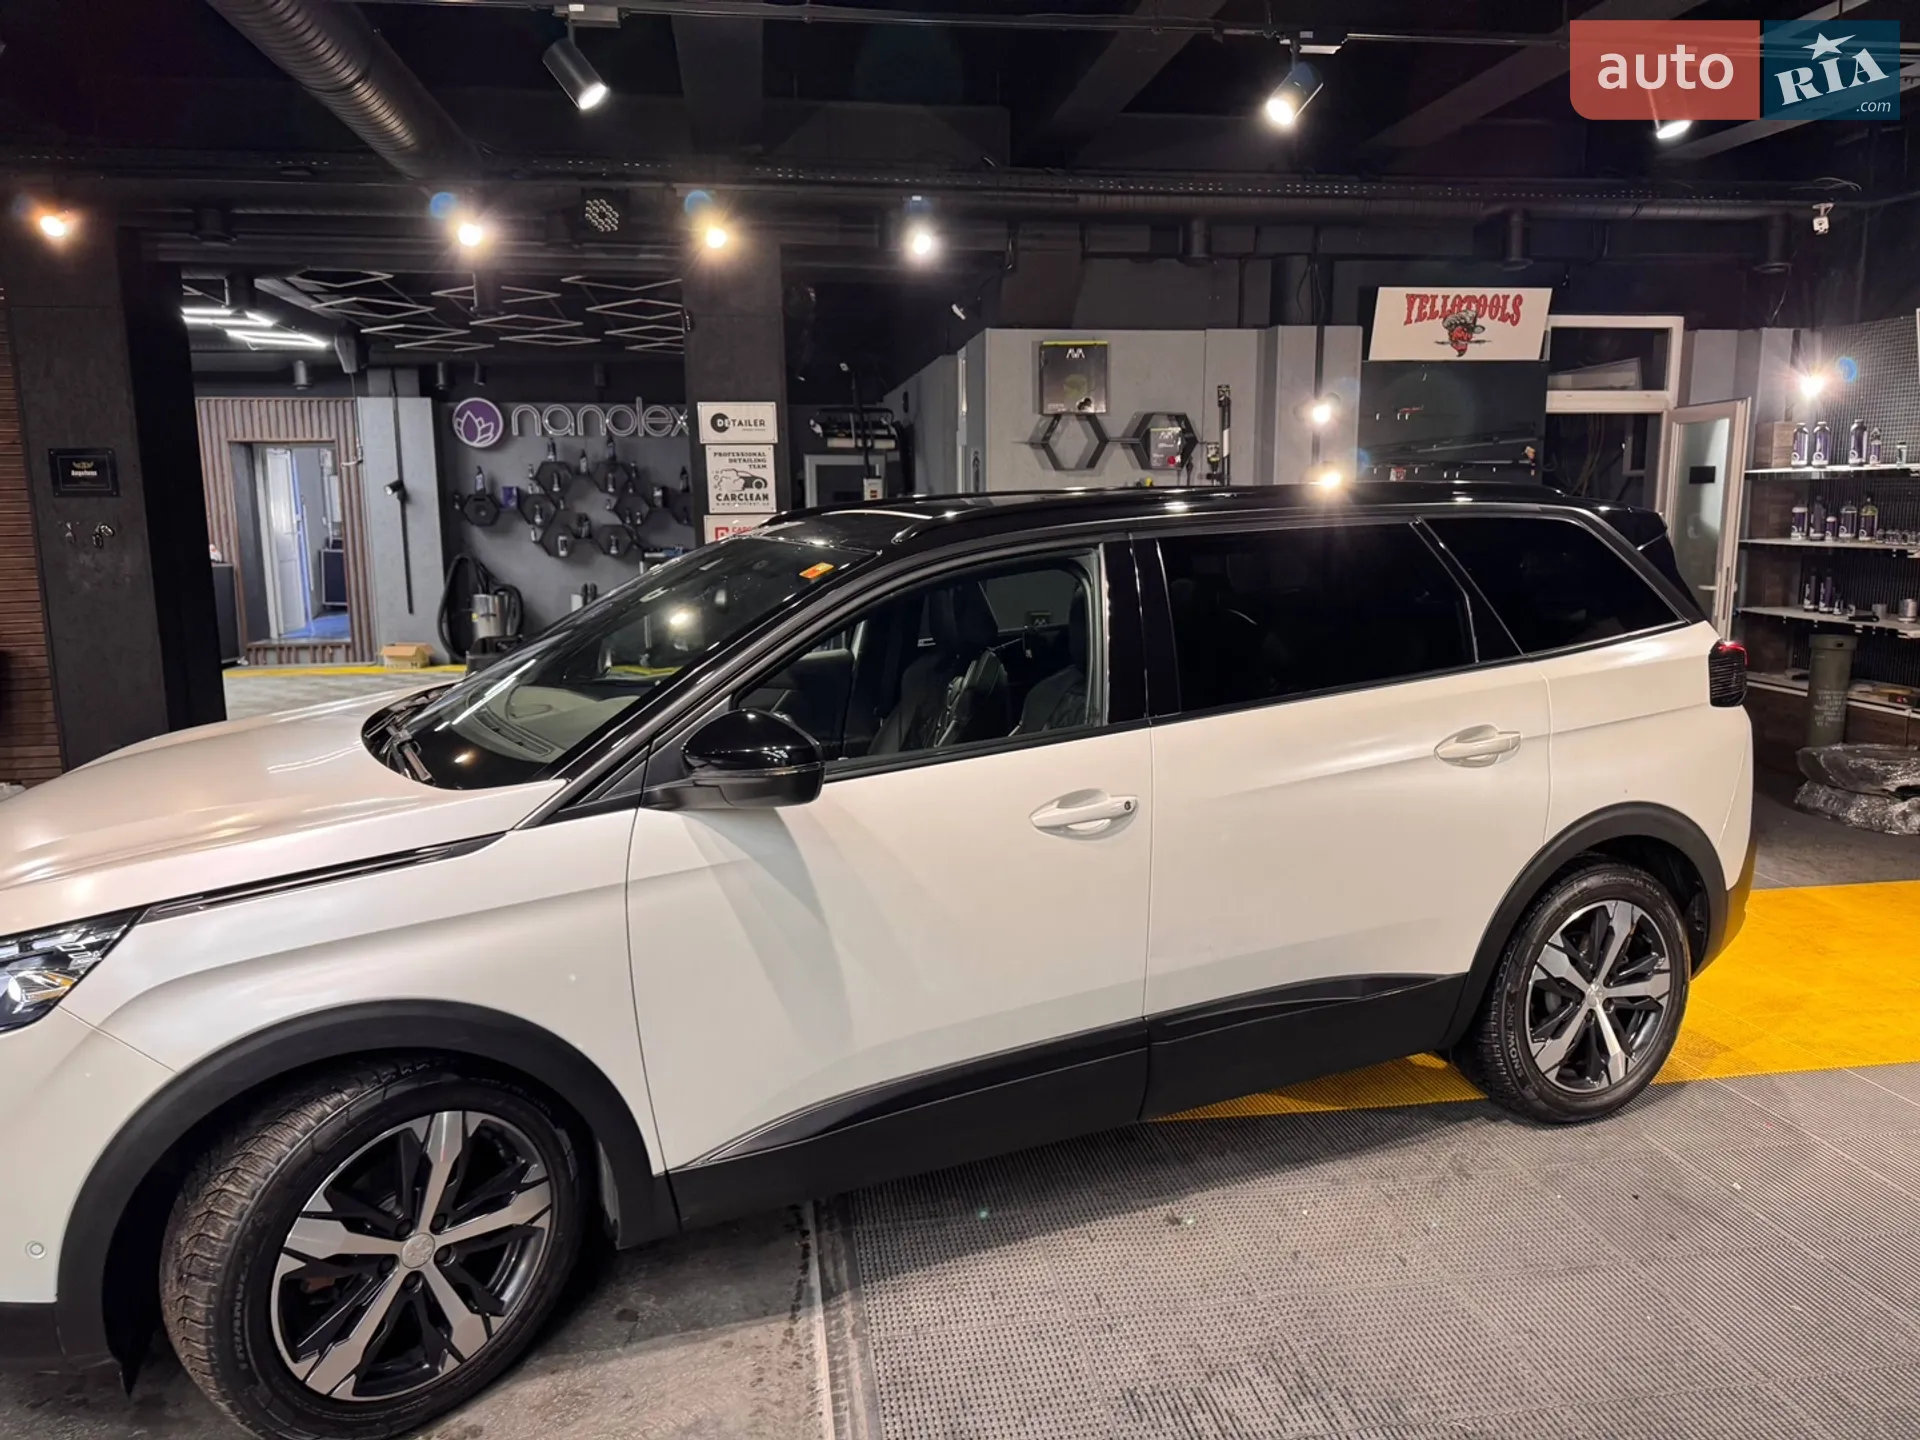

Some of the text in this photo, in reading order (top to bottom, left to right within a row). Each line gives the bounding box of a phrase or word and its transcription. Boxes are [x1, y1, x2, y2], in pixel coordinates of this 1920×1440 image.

[511, 396, 690, 437] nanolex
[716, 493, 769, 501] CARCLEAN
[1507, 1002, 1524, 1077] SNOWLINK
